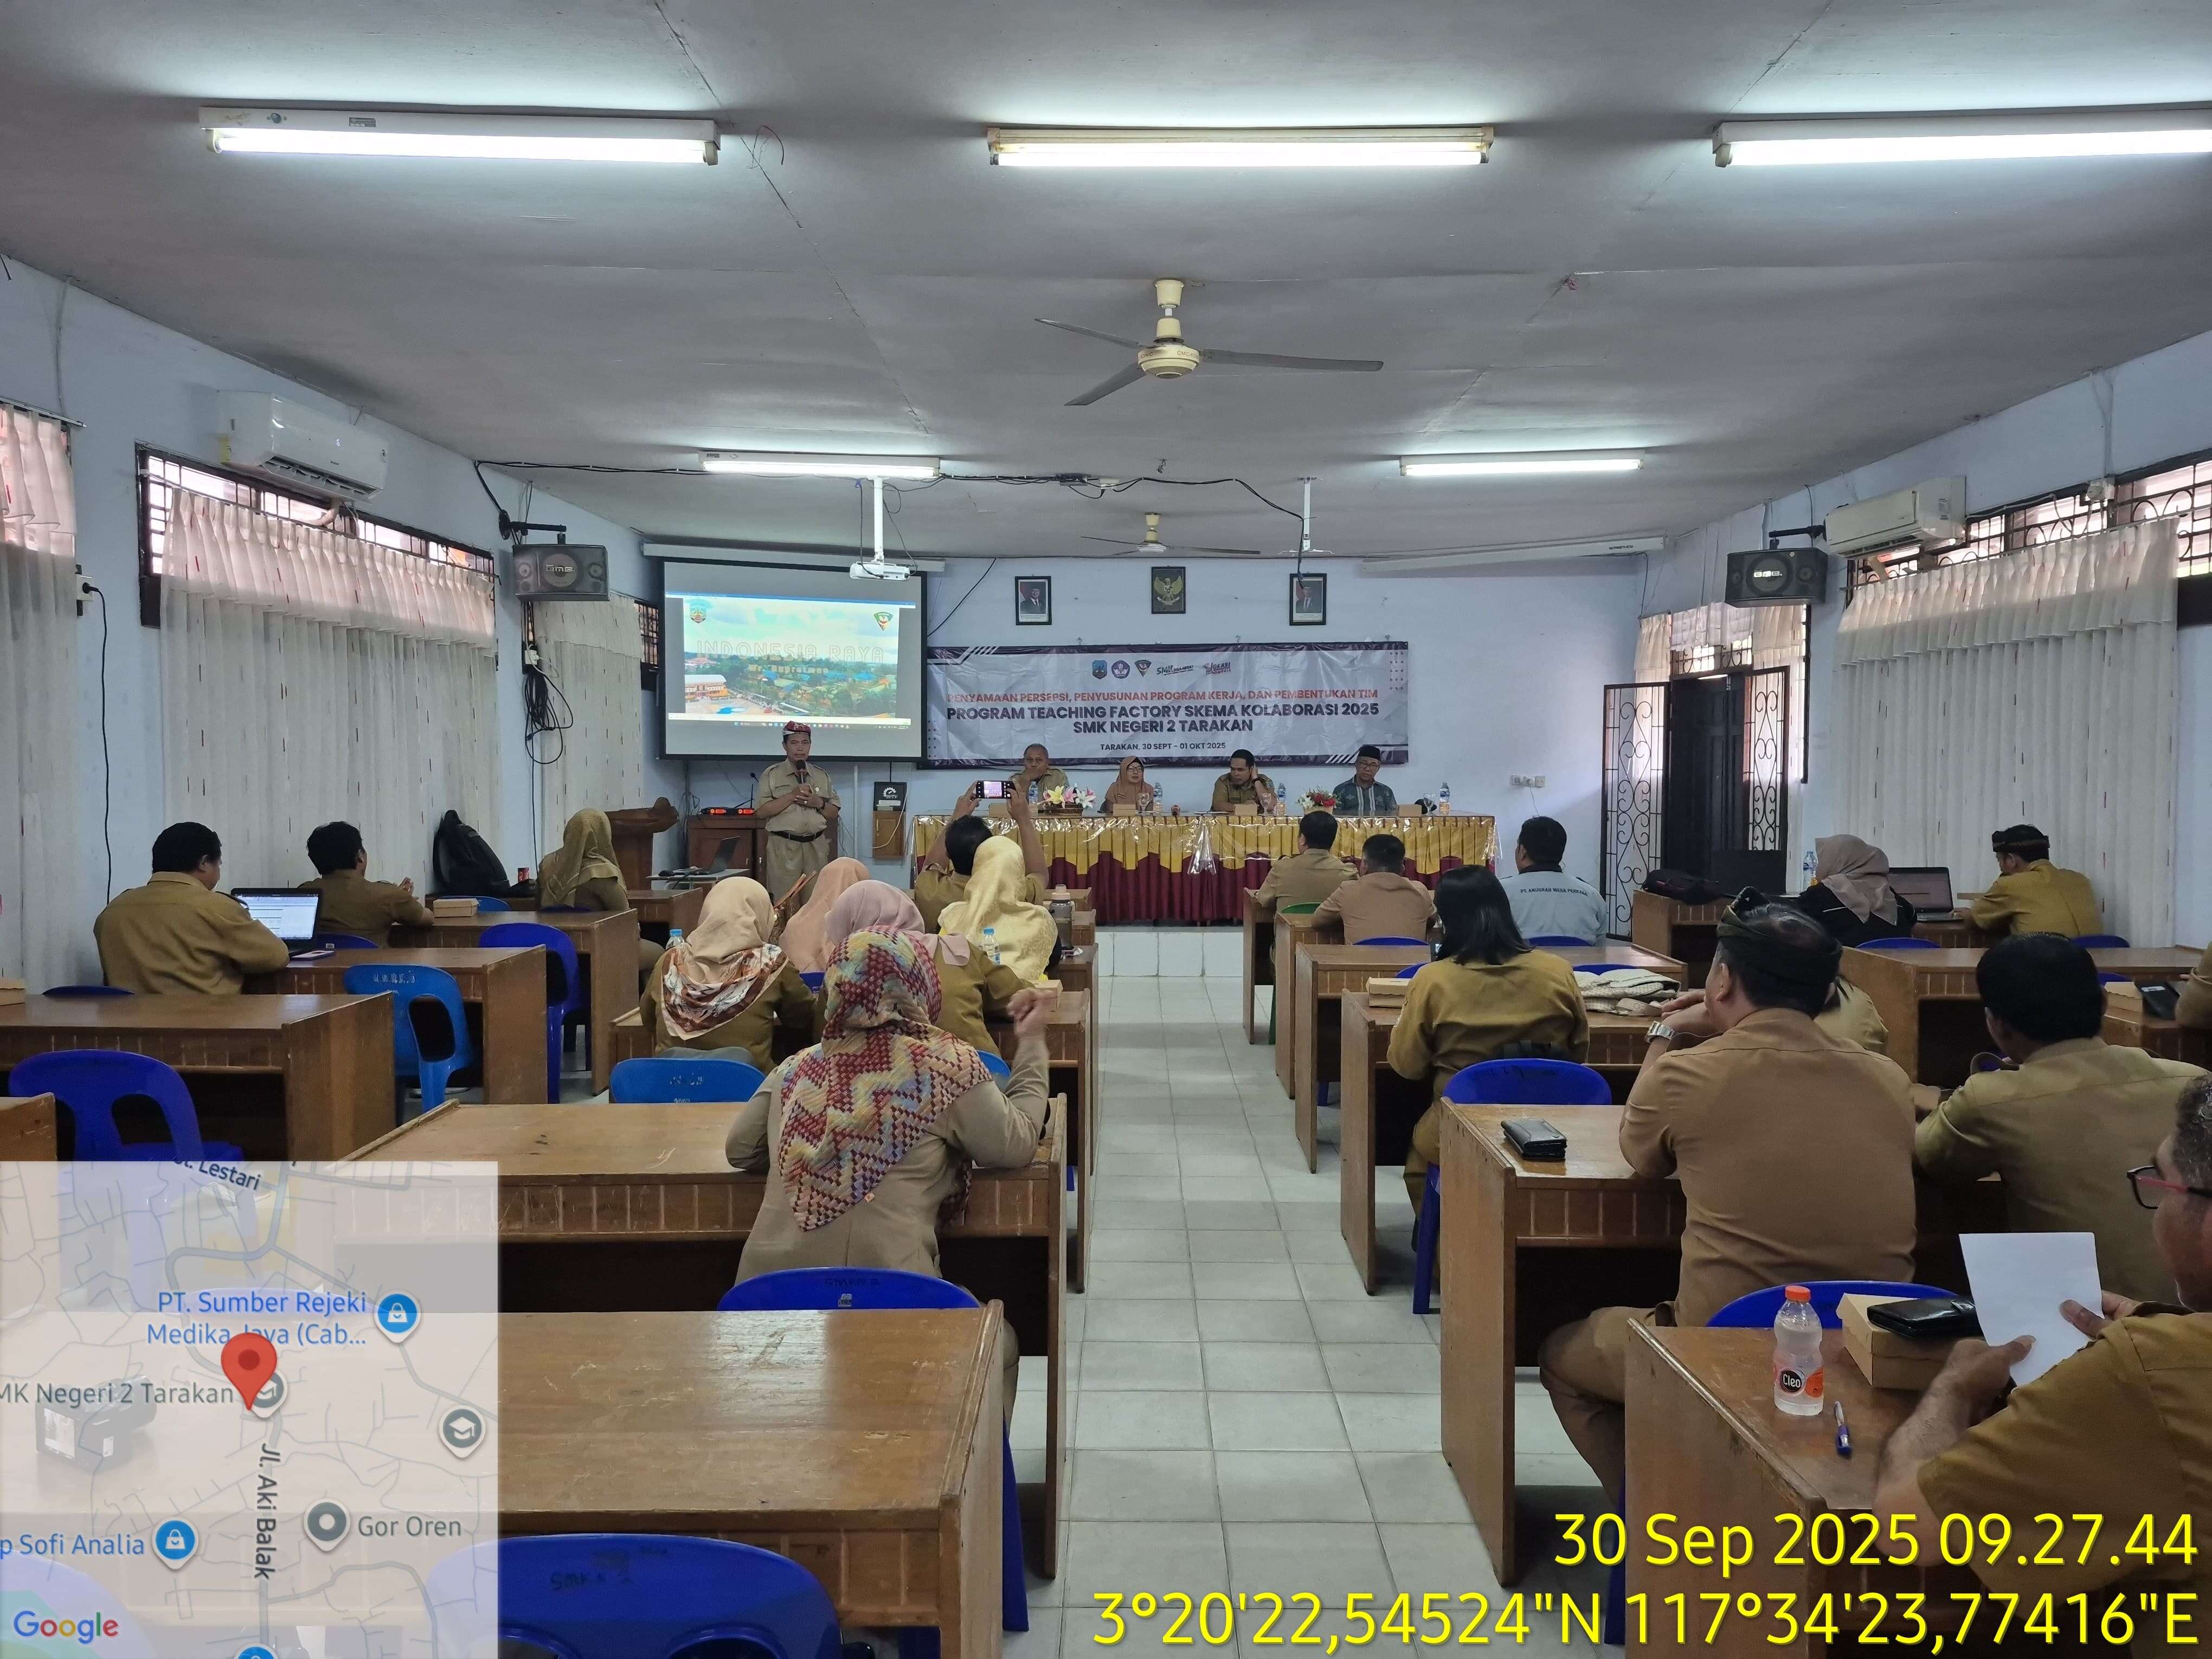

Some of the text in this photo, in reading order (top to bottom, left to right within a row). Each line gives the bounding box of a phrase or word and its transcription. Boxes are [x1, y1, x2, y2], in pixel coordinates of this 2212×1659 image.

[697, 640, 884, 663] INDONESIA RAYA
[947, 689, 1378, 703] PENYAMAAN PERSEPSI, PENYUSUNAN PROGRAM KERJA, DAN PEMBENTUKAN TIM
[947, 703, 1379, 720] PROGRAM TEACHING FACTORY SKEMA KOLABORASI 2025
[1073, 719, 1253, 733] SMK NEGERI 2 TARAKAN
[1783, 1373, 1801, 1388] Cleo
